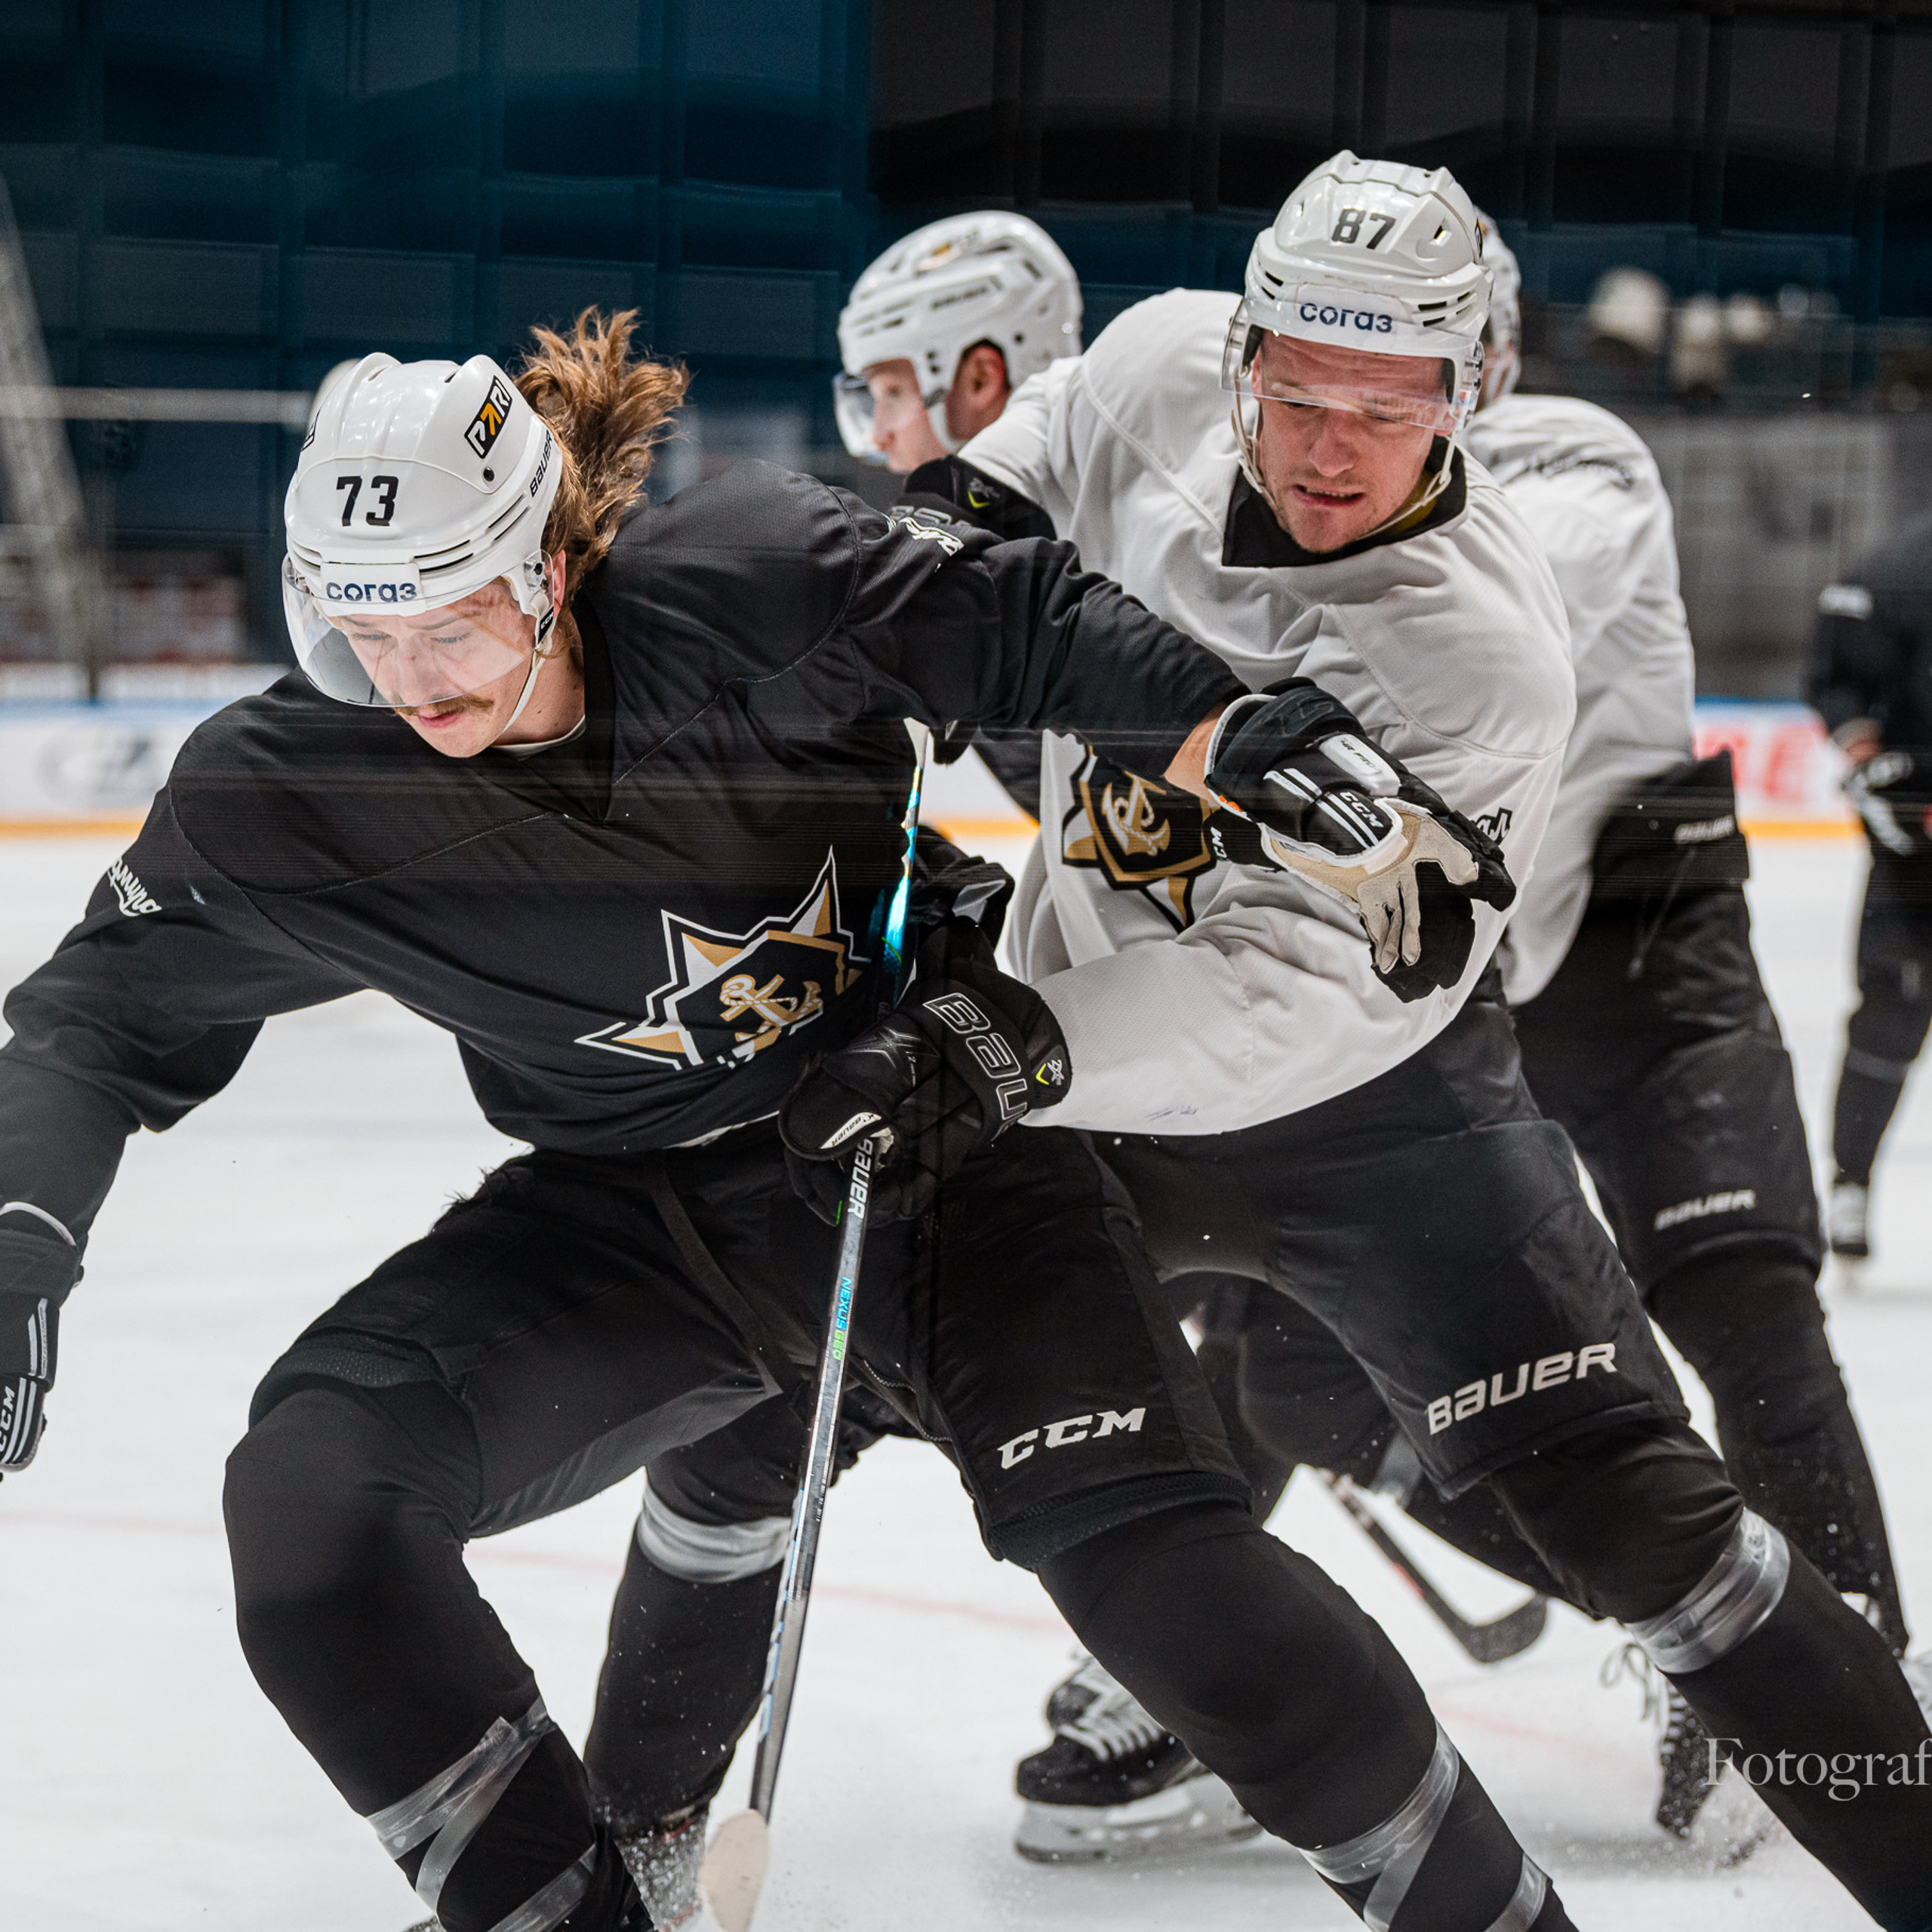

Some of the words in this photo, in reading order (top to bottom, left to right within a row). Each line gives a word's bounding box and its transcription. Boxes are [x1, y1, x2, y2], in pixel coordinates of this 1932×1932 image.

[1331, 208, 1396, 250] 87
[1300, 303, 1393, 333] согаз
[336, 475, 398, 526] 73
[326, 581, 417, 601] согаз
[1340, 791, 1383, 827] CCM
[923, 992, 1028, 1137] BAU
[848, 1139, 873, 1219] BAUER
[835, 1276, 853, 1331] NEXUS
[1426, 1343, 1618, 1435] BAUER
[997, 1407, 1146, 1470] CCM
